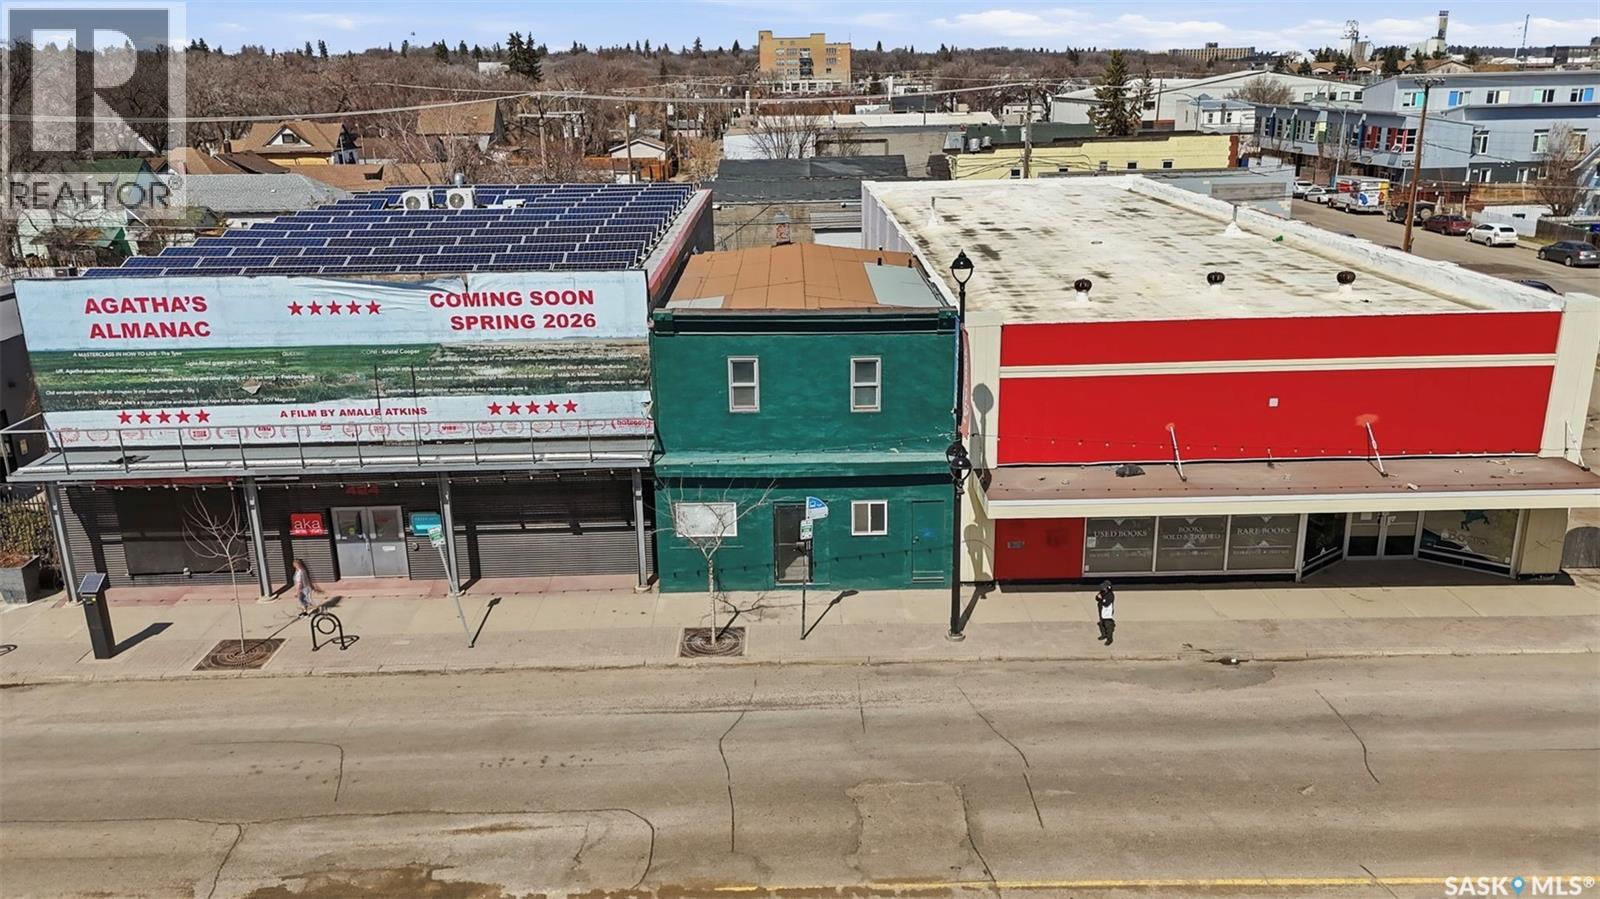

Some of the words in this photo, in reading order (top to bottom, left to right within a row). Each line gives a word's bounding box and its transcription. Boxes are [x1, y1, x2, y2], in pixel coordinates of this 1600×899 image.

[84, 295, 208, 314] AGATHA'S
[429, 290, 523, 308] COMING
[530, 289, 594, 306] SOON
[89, 321, 211, 339] ALMANAC
[450, 313, 536, 331] SPRING
[542, 312, 597, 328] 2026
[280, 409, 288, 418] A
[290, 409, 318, 418] FILM
[320, 408, 335, 418] BY
[339, 408, 381, 417] AMALIE
[385, 407, 428, 416] ATKINS
[294, 518, 320, 530] aka
